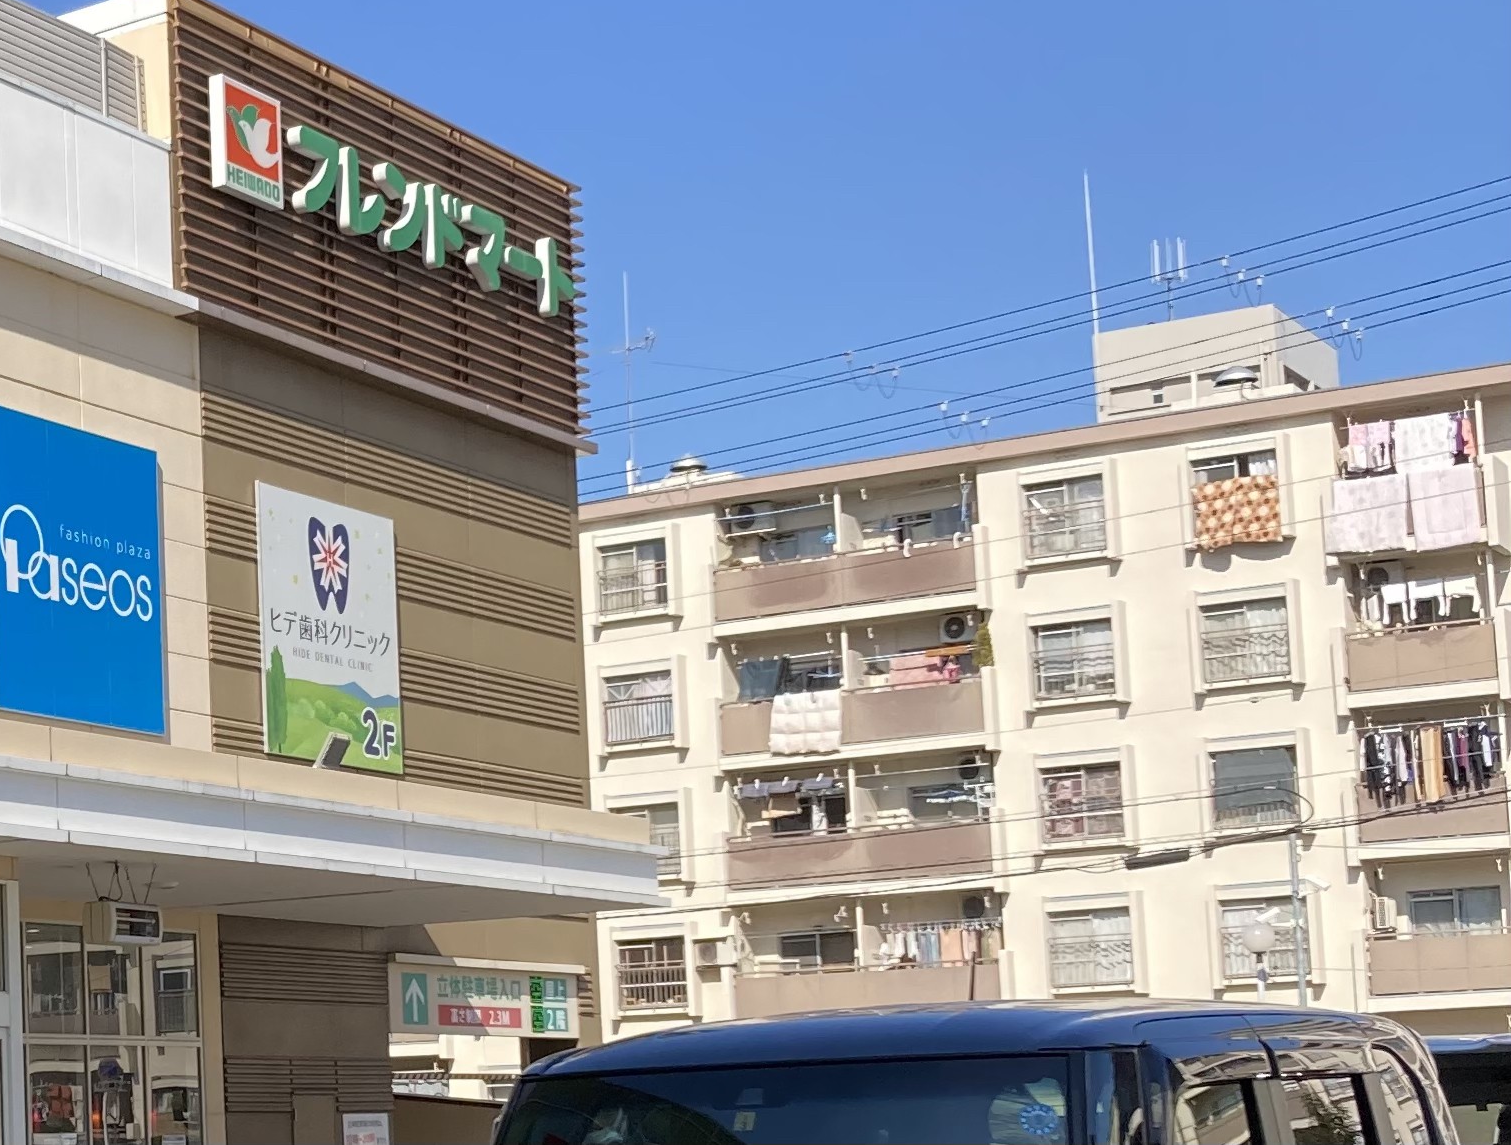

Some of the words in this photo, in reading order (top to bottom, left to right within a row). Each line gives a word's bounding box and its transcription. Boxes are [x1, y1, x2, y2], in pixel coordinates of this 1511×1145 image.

[227, 163, 281, 203] HEIWADO
[287, 125, 575, 318] フレンドマート
[0, 503, 153, 622] Paseos
[59, 523, 110, 550] fashion
[116, 540, 151, 560] plaza
[270, 607, 391, 657] ヒデ歯科クリニック
[292, 646, 311, 660] HIDE
[315, 650, 344, 668] DENTAL
[347, 657, 375, 673] CLINIC
[362, 707, 396, 760] 2F
